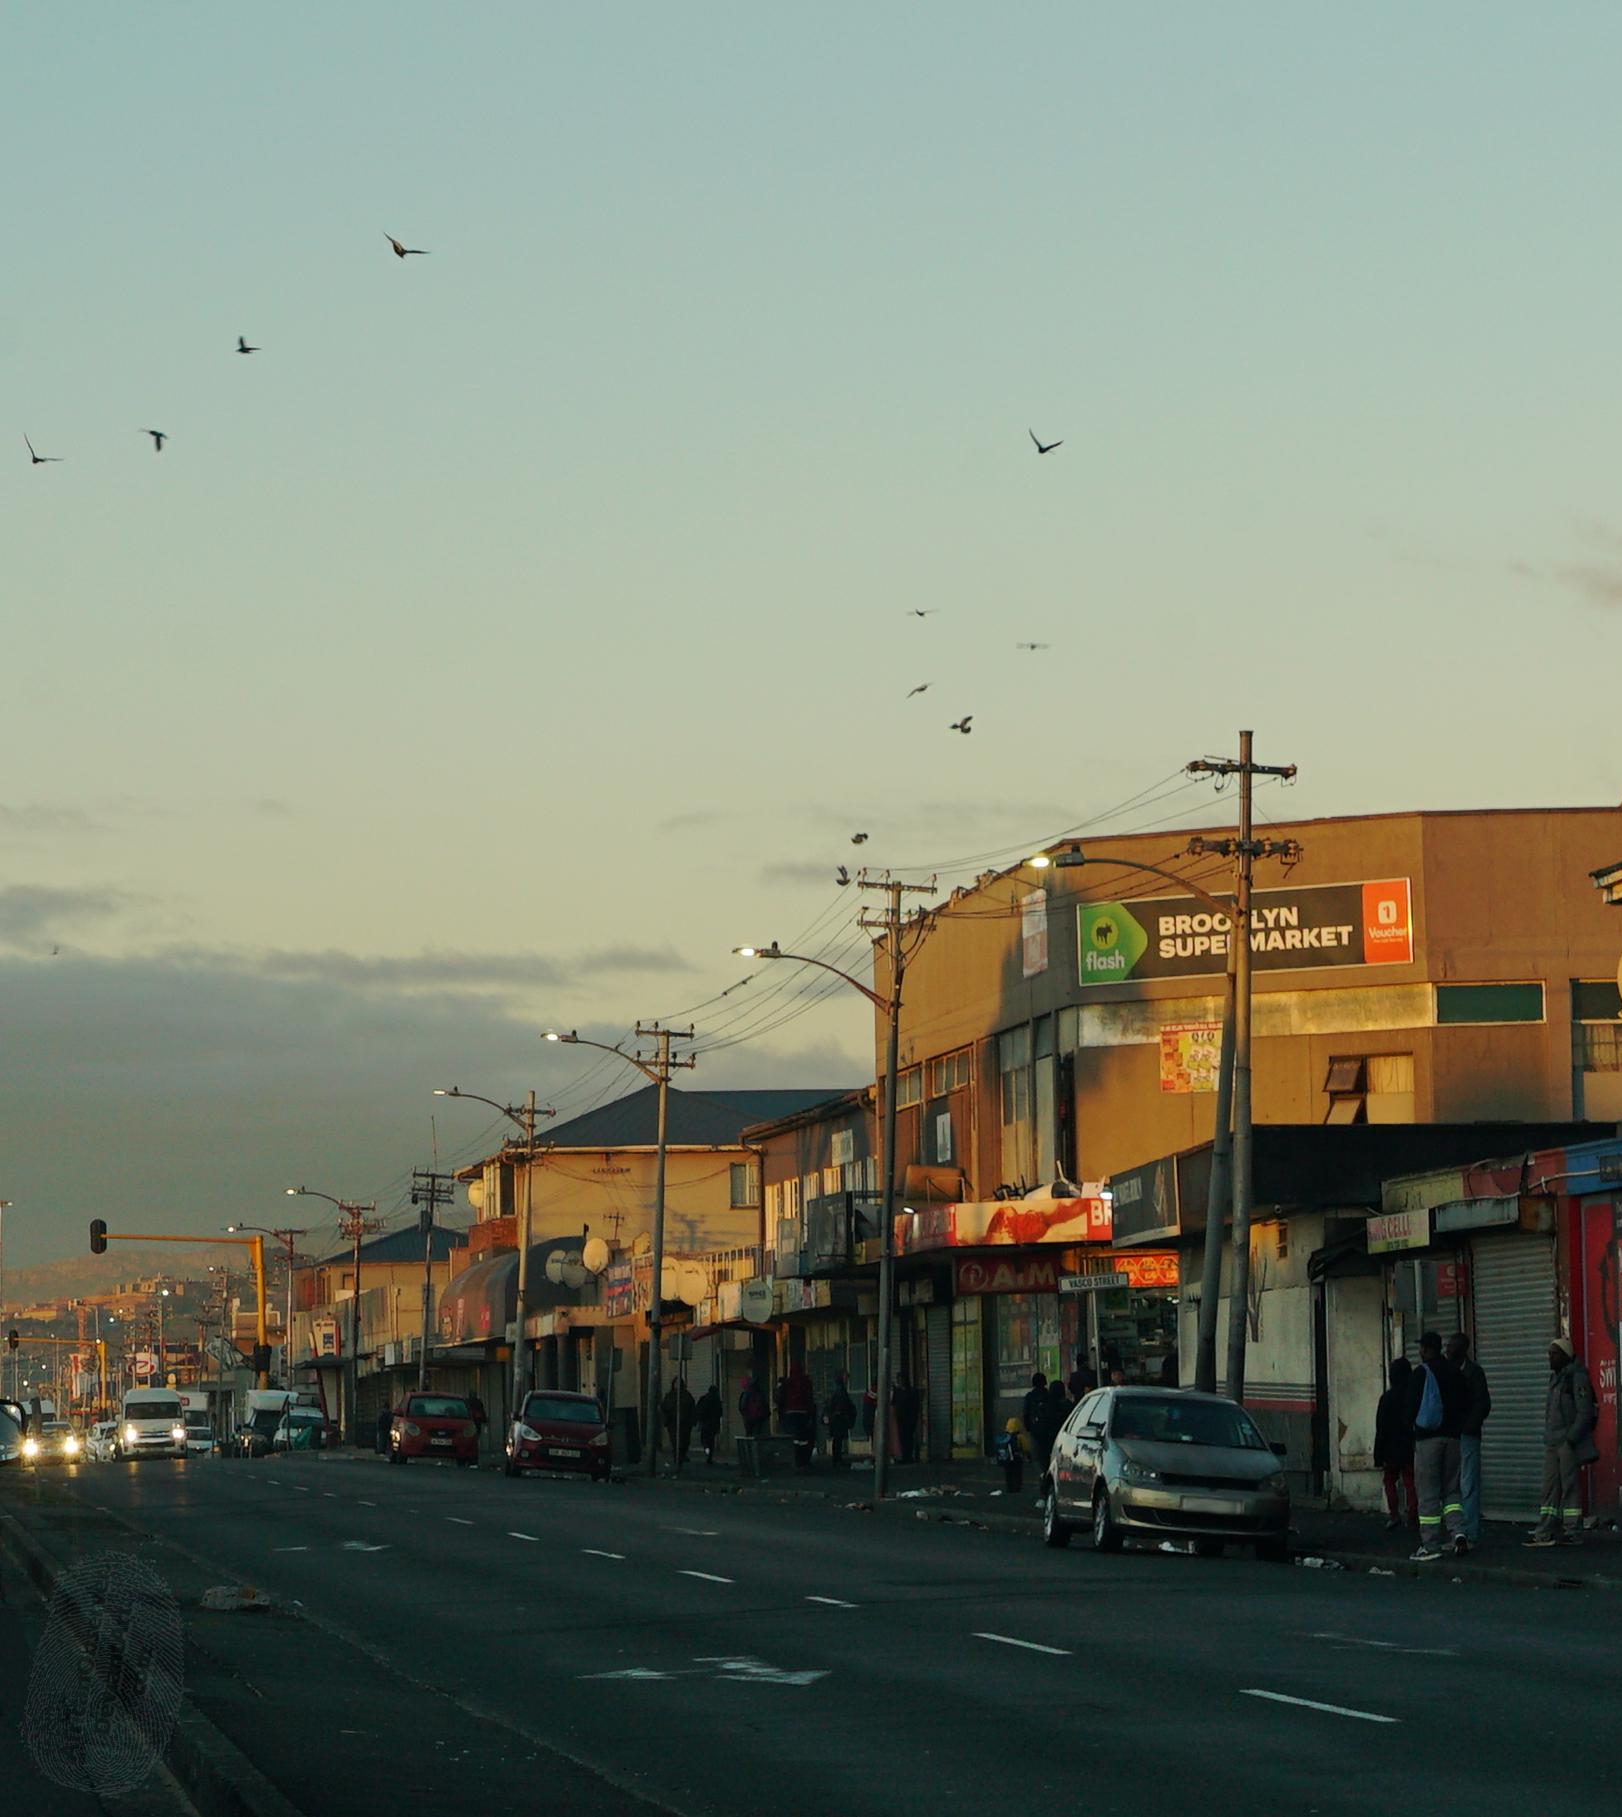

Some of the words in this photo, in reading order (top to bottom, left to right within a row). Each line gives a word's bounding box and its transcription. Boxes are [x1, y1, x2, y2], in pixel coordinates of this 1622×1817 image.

[1158, 906, 1299, 937] BROOLYN
[1158, 925, 1354, 959] SUPEMARKET
[1086, 951, 1125, 971] flash
[1070, 1278, 1092, 1289] VASCO
[1094, 1276, 1120, 1287] STREET
